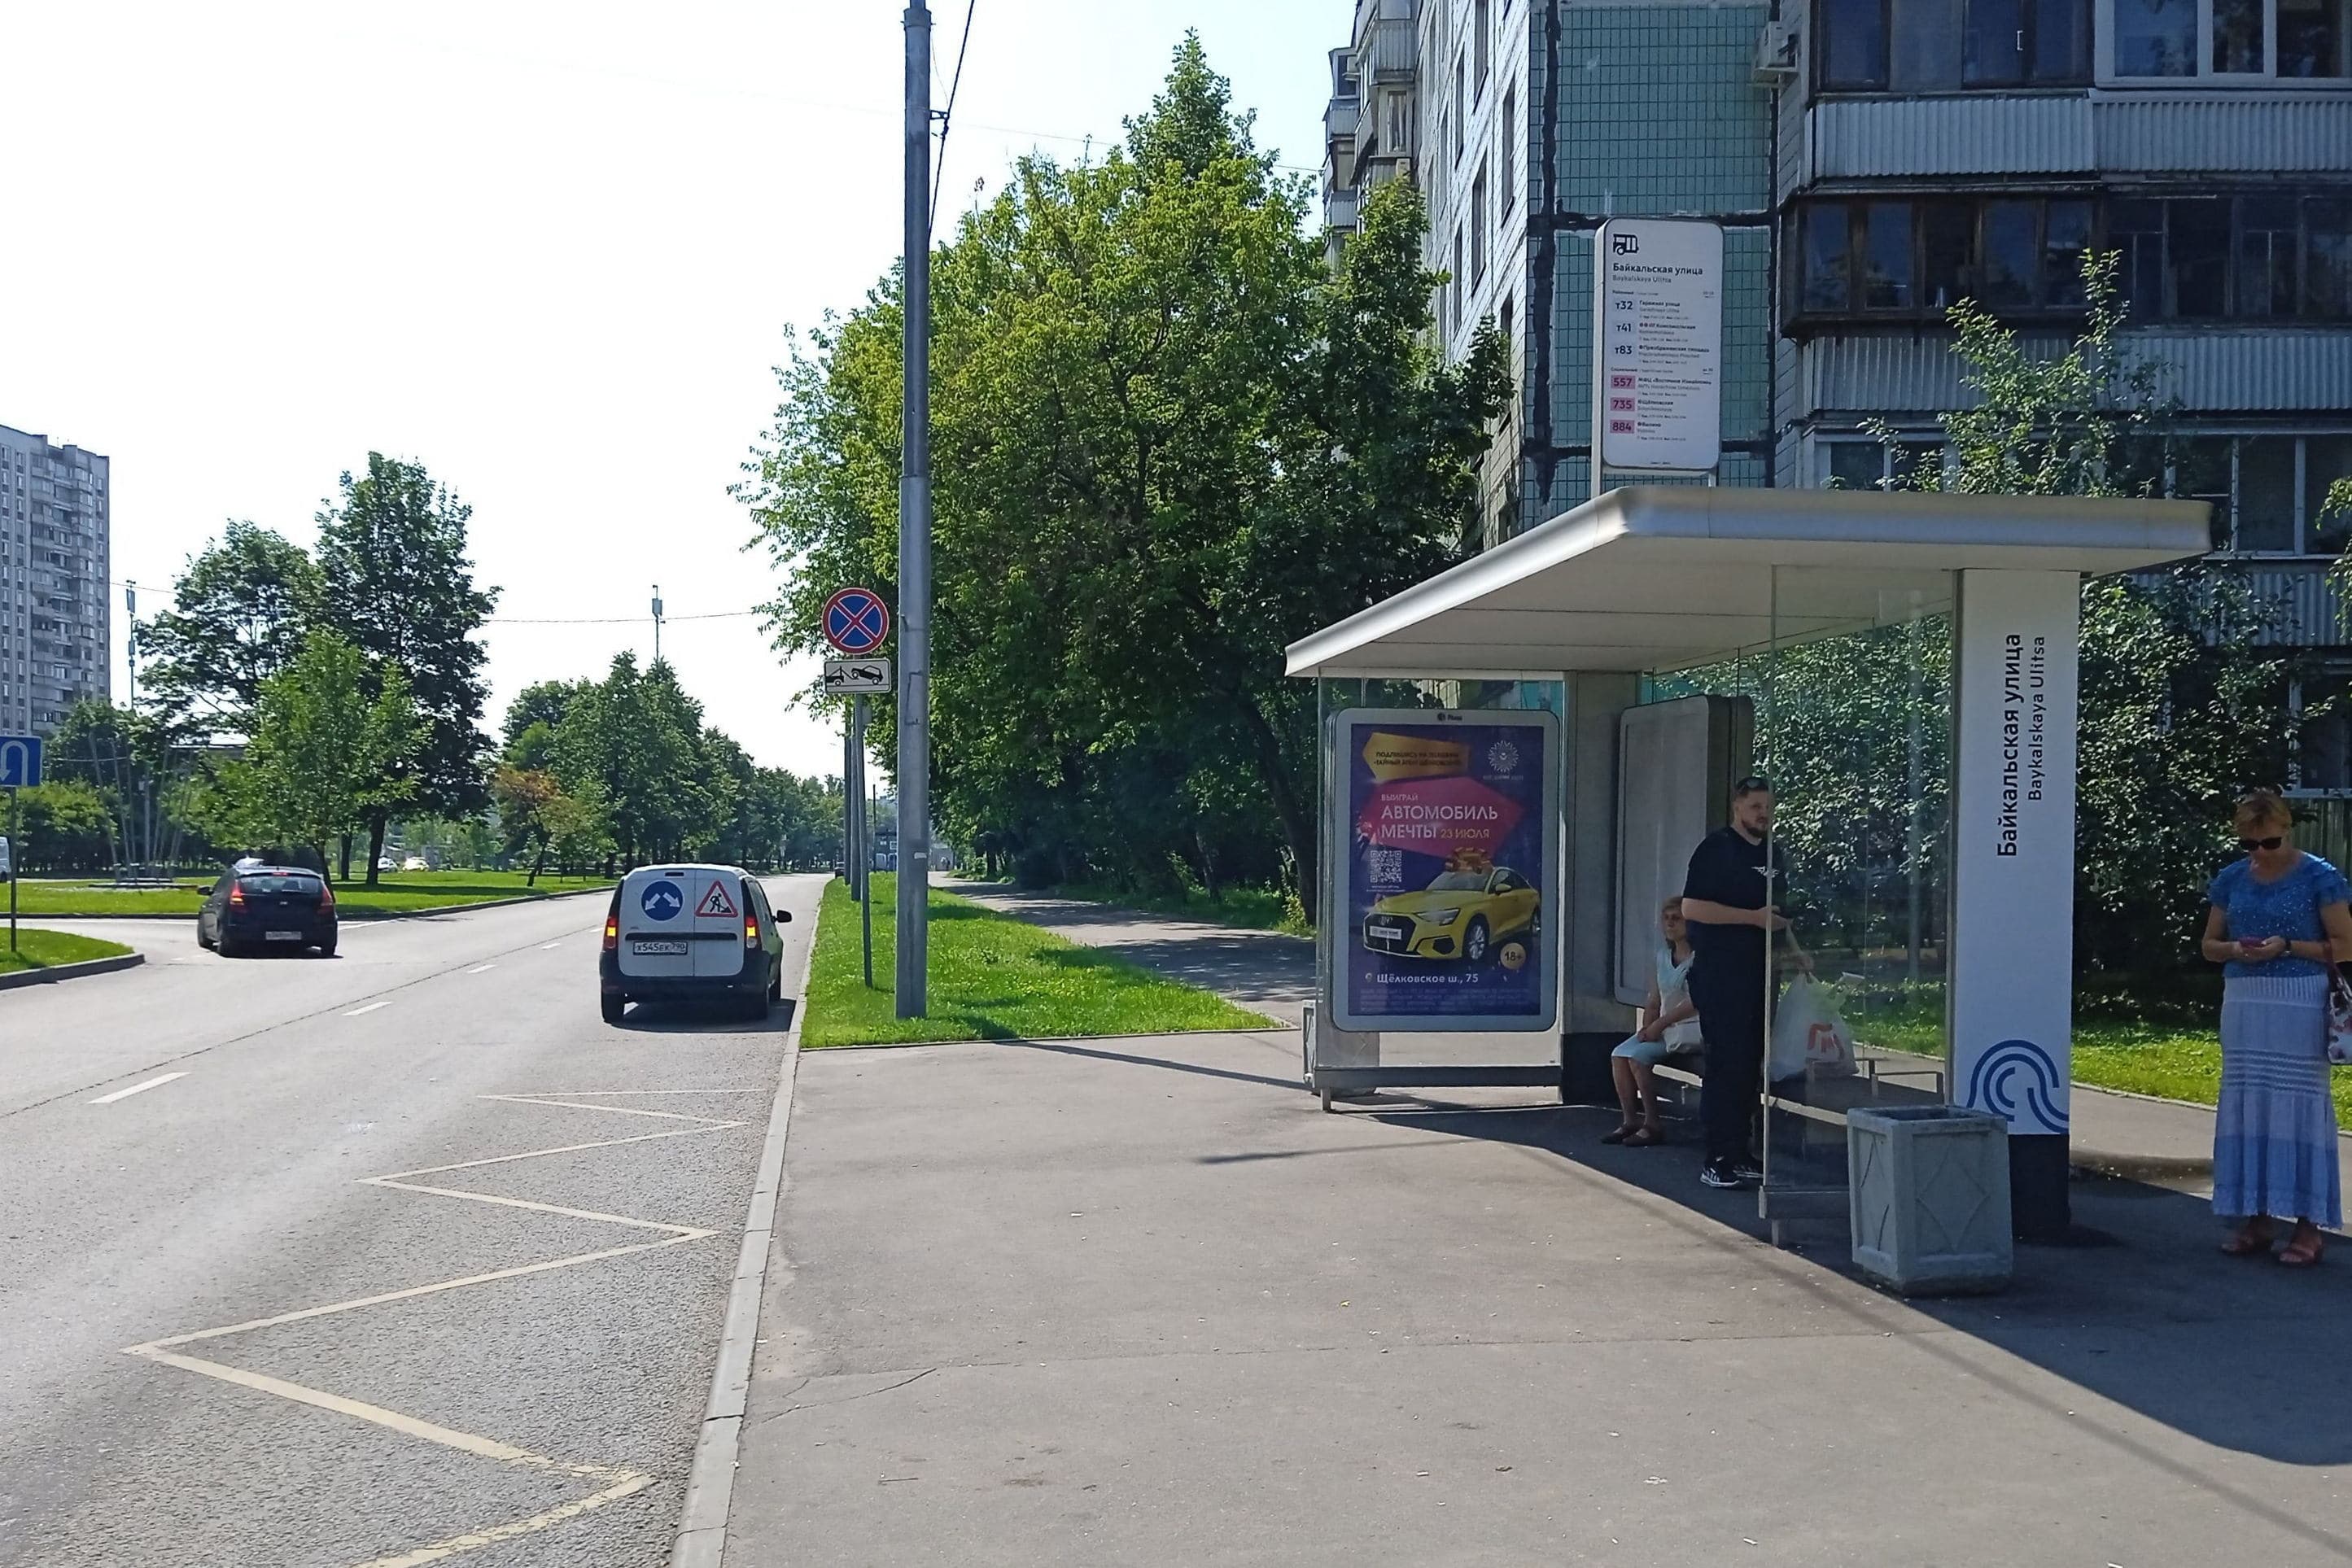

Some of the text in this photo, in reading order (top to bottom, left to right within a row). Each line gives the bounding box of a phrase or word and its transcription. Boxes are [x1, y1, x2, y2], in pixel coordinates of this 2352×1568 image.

[1613, 263, 1703, 275] Байкальская улица
[1615, 301, 1633, 310] т32
[1615, 345, 1633, 355] т83
[1613, 378, 1632, 387] 557
[1613, 400, 1632, 409] 735
[1612, 422, 1632, 431] 884
[2028, 636, 2046, 801] Baykalskaya Ulitsa
[1996, 634, 2024, 856] Байкальская улица
[1381, 793, 1419, 801] ВЫИГРАЙ
[1381, 806, 1498, 819] АВТОМОБИЛЬ
[1381, 825, 1490, 838] МЕЧТЫ 23 ИЮЛЯ
[1504, 951, 1523, 962] 18+
[1377, 972, 1445, 983] Щёлковское
[1466, 974, 1479, 983] 75
